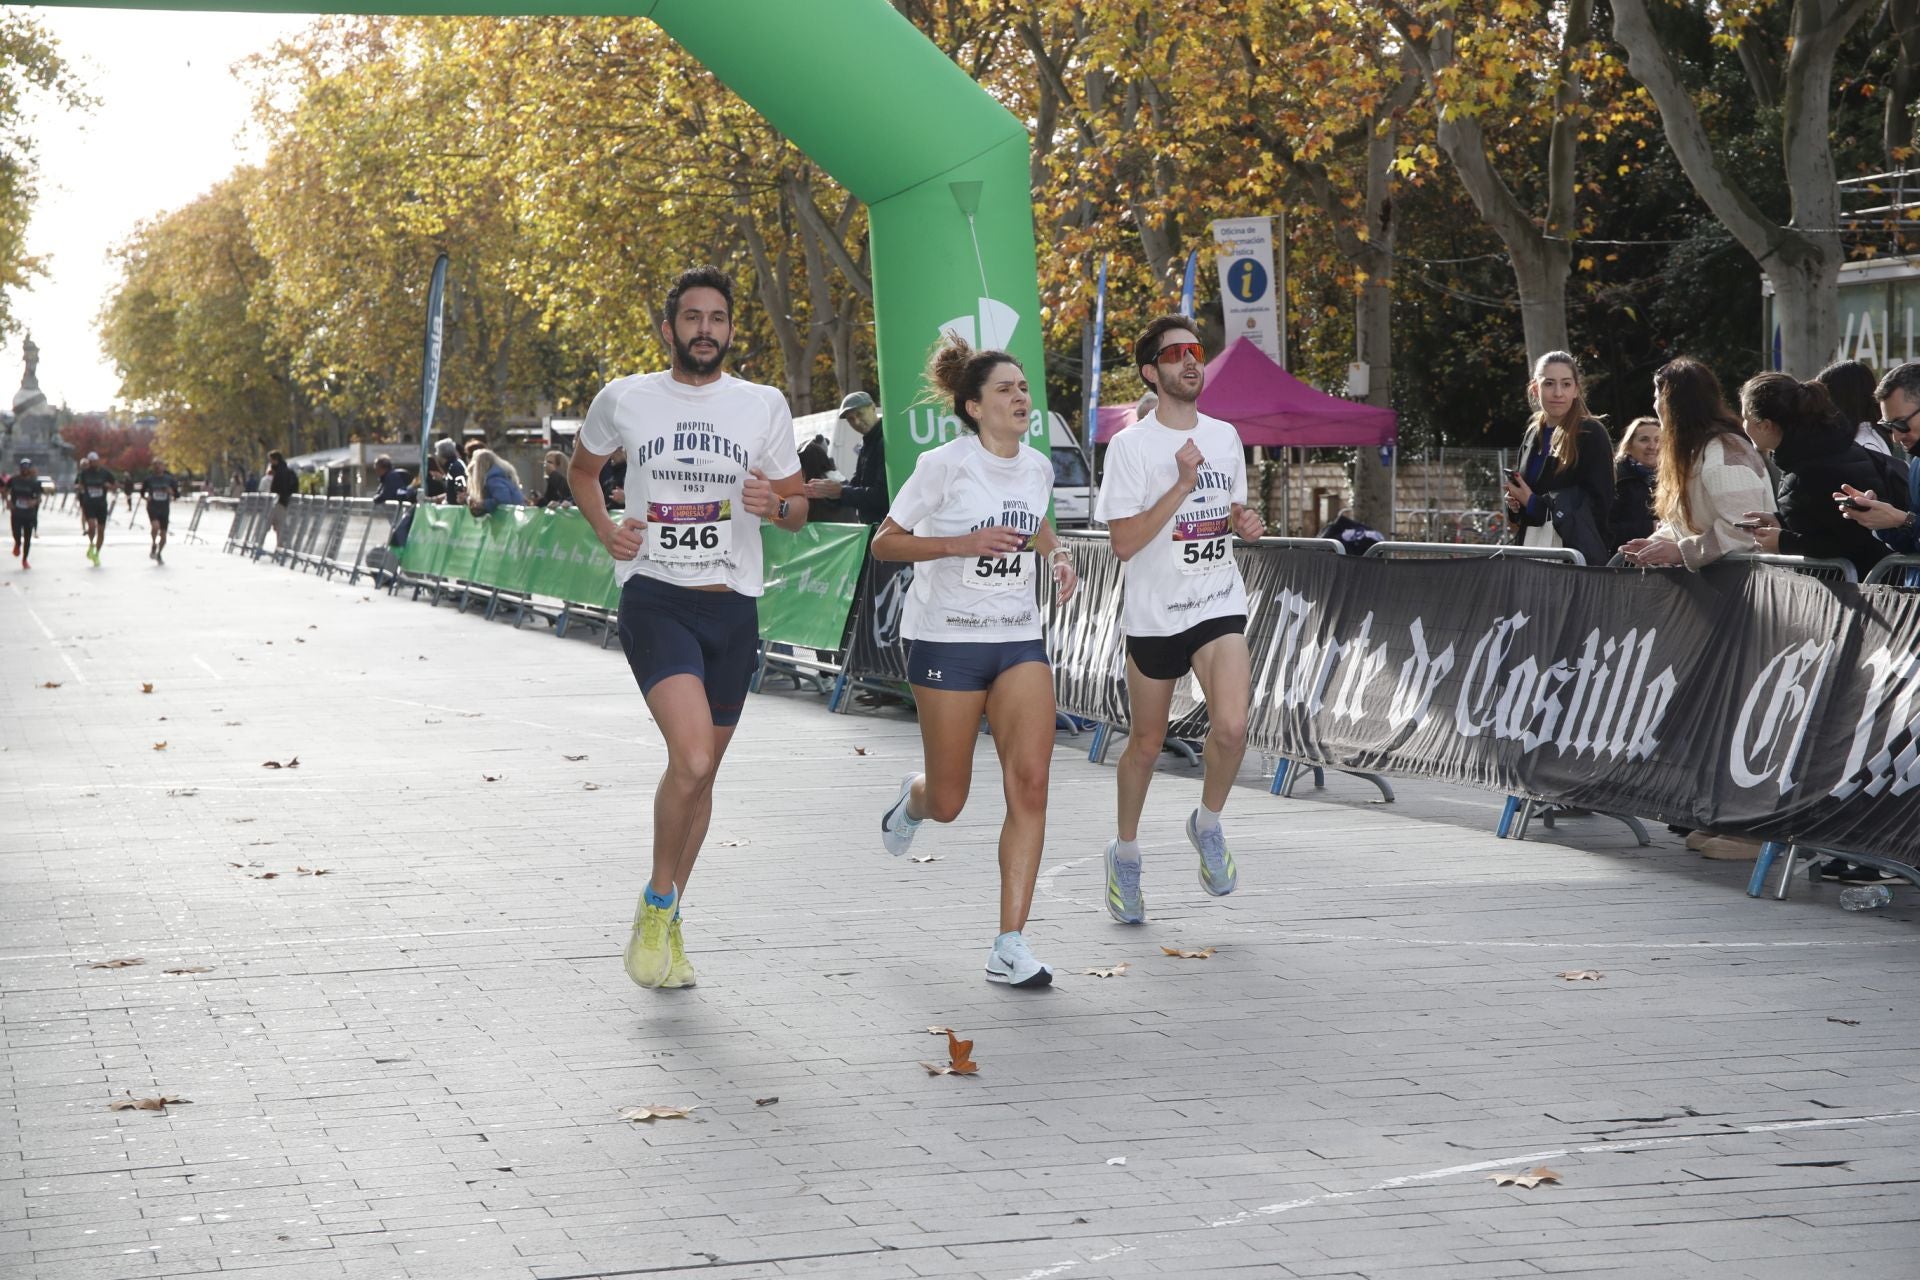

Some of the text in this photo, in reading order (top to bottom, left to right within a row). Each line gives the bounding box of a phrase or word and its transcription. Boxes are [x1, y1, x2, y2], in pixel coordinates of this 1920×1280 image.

[676, 421, 715, 433] HOSPITAL
[639, 432, 749, 472] RIO HORTEGA
[652, 469, 737, 485] UNIVERSITARIO
[683, 484, 705, 493] 1953
[660, 525, 719, 550] 546
[1183, 538, 1226, 564] 545
[975, 554, 1022, 578] 544
[1386, 616, 1454, 732] de
[1455, 609, 1678, 763] Castilla
